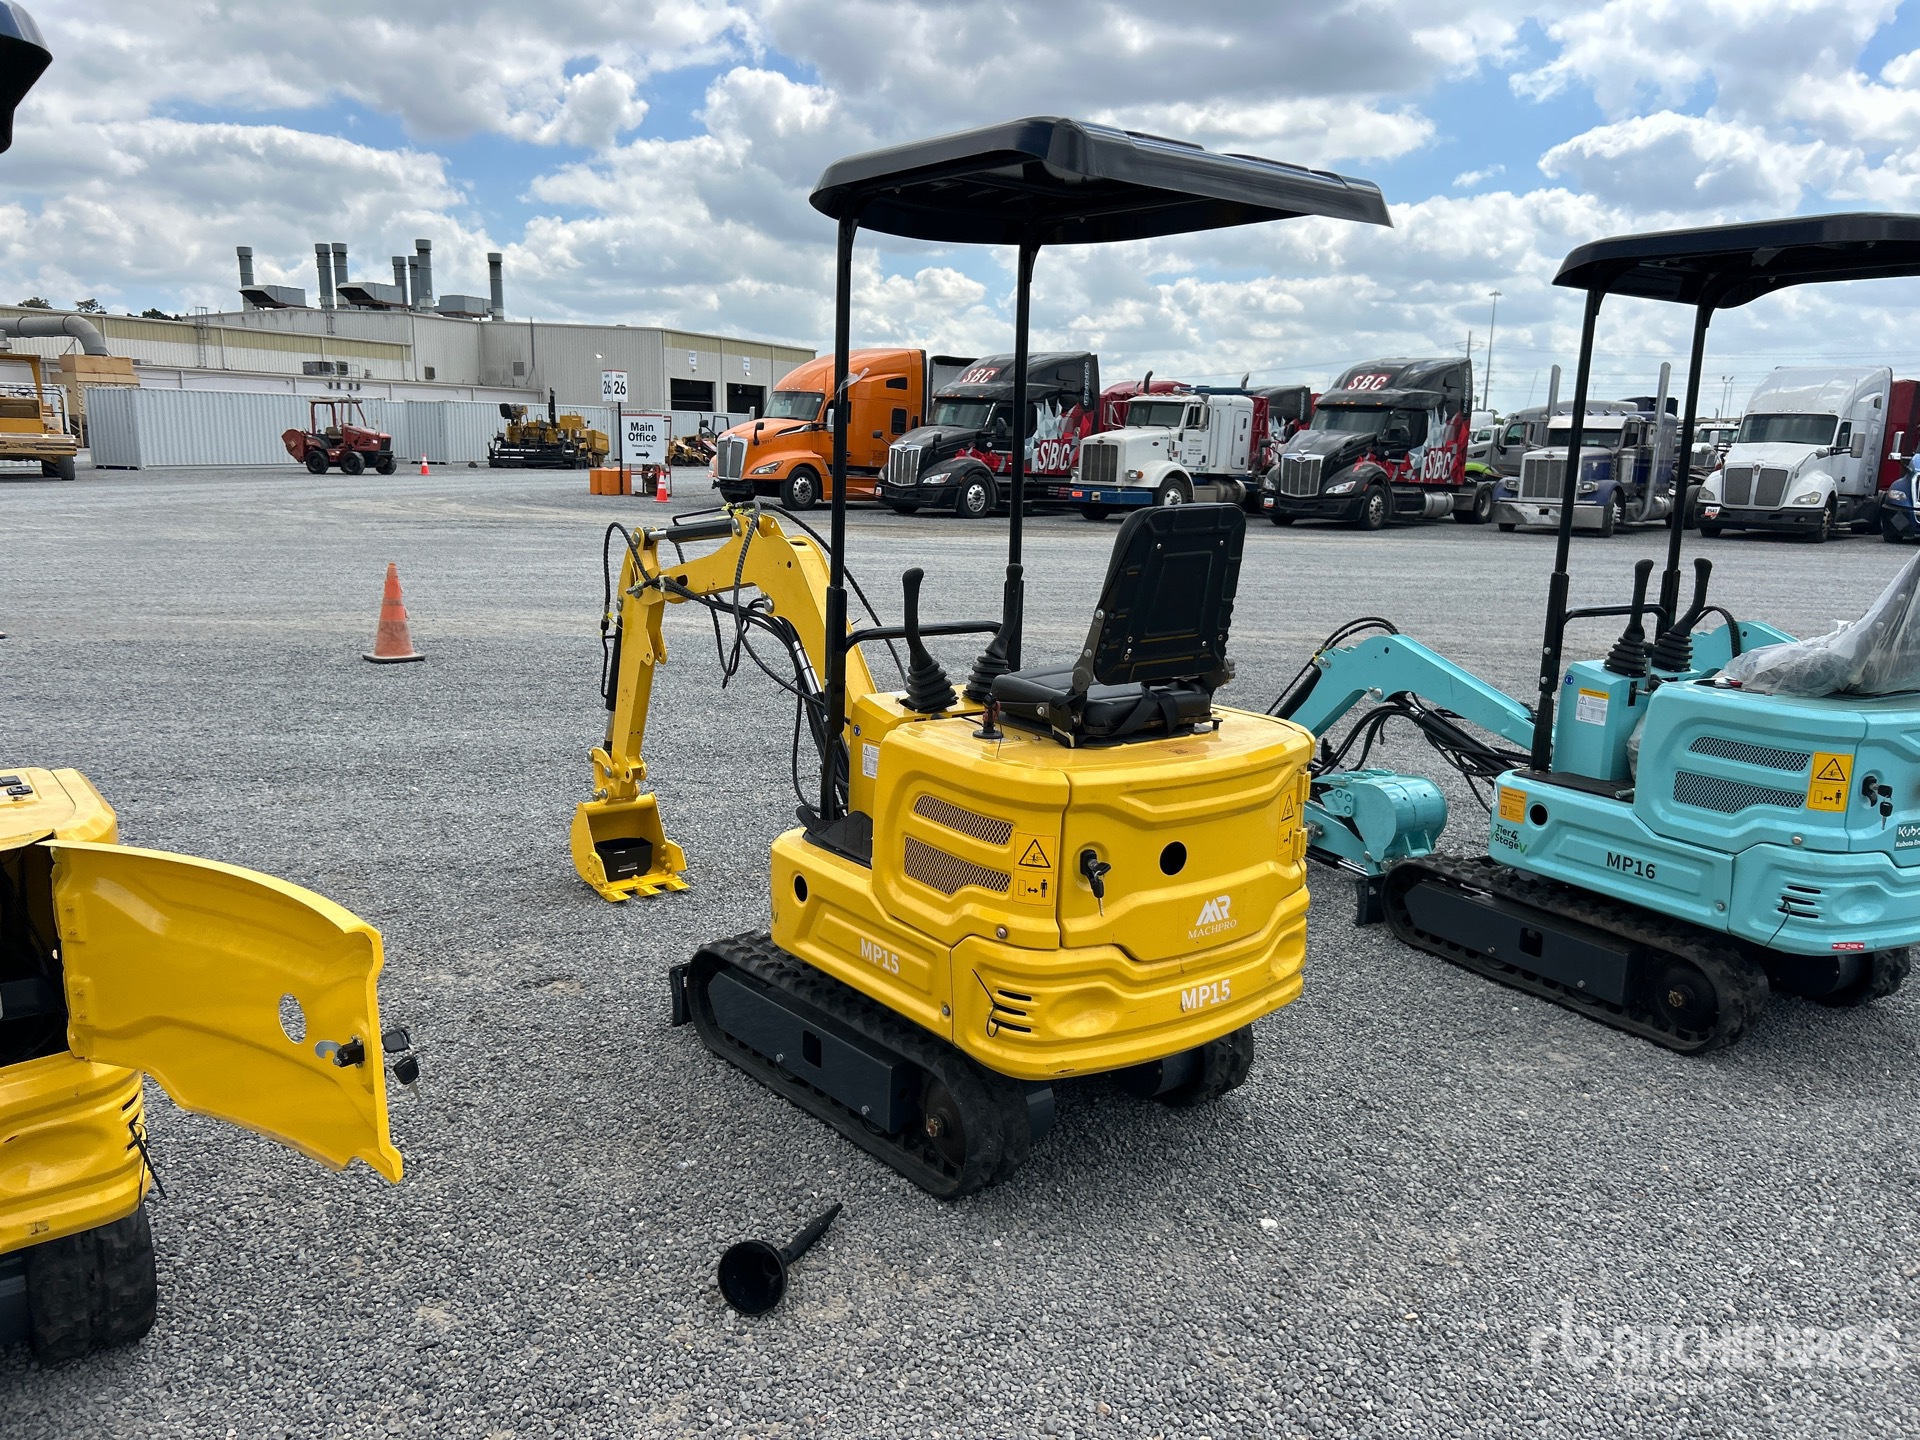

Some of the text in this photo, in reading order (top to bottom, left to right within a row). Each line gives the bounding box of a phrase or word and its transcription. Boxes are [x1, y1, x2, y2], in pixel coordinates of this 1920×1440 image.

[962, 368, 996, 384] SBC
[1347, 374, 1388, 391] SBC
[603, 380, 612, 395] 26
[613, 380, 627, 395] 26
[630, 421, 654, 432] Main
[627, 432, 657, 442] Office
[1038, 441, 1071, 471] SBC
[1425, 449, 1452, 480] SBC
[1606, 851, 1656, 880] MP16
[1187, 919, 1237, 939] MACHPRO
[861, 937, 900, 975] MP15
[1181, 979, 1231, 1012] MP15
